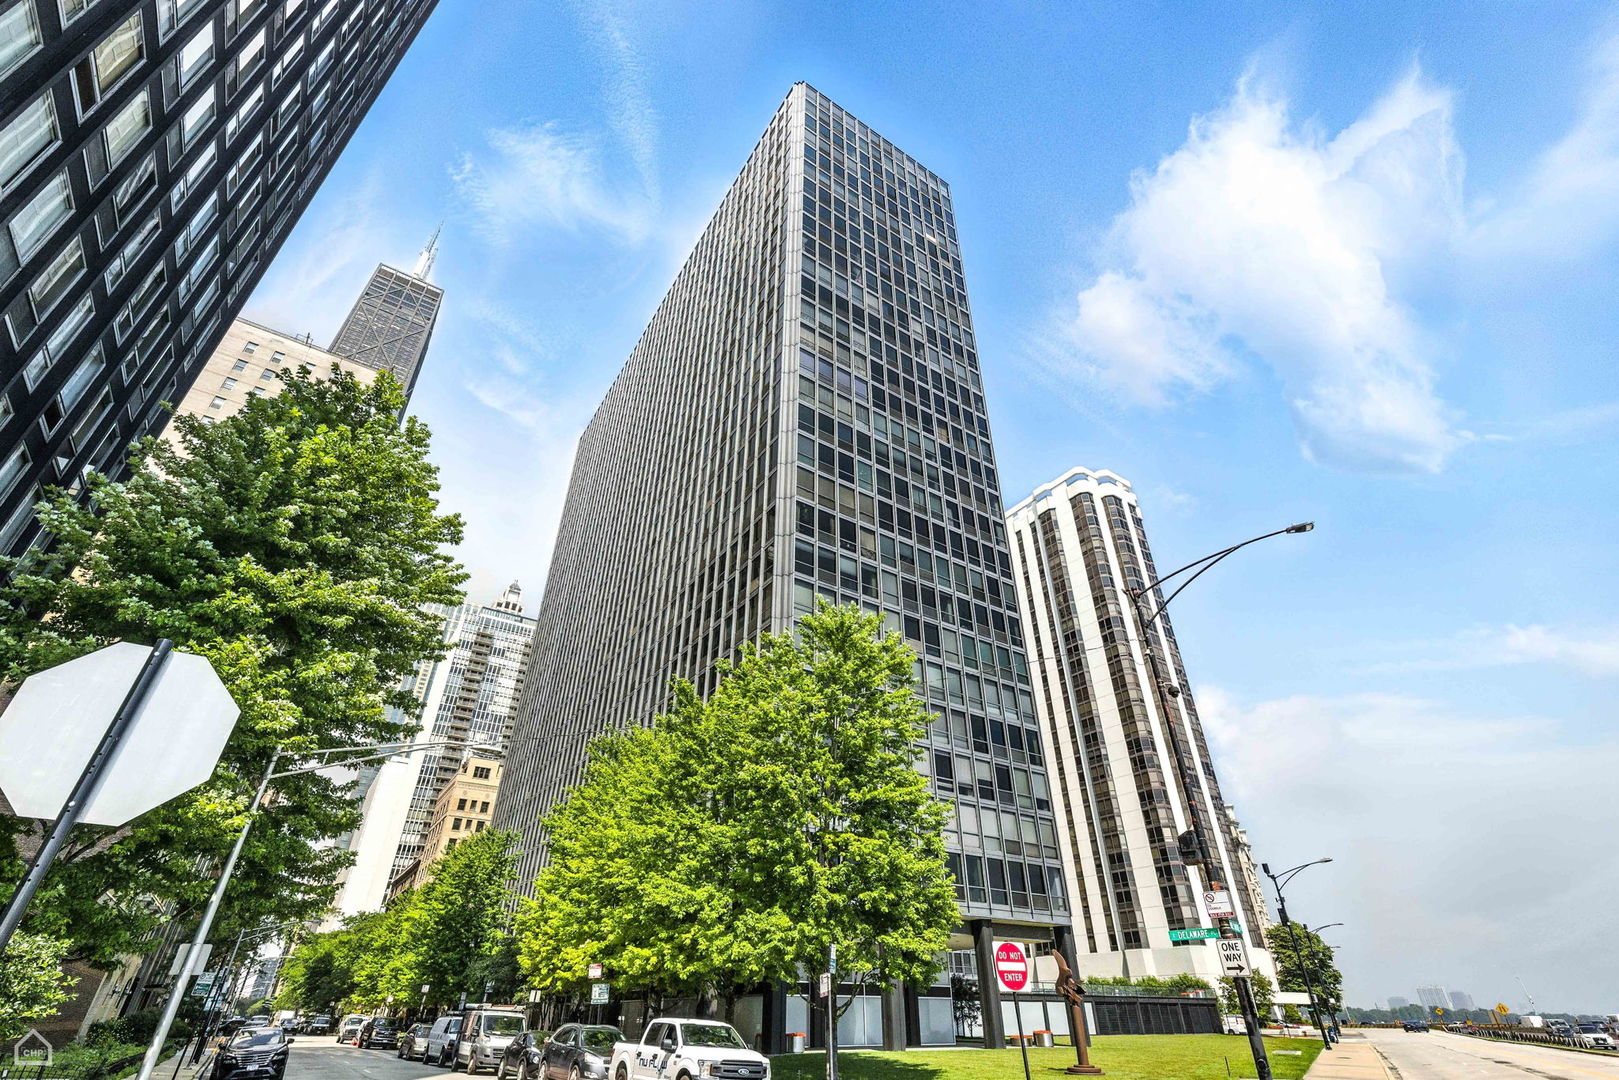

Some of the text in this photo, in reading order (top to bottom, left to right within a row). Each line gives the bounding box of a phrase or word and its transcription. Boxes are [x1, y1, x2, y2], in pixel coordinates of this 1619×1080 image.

[1177, 930, 1209, 939] DELAWARE
[1221, 942, 1240, 951] ONE
[1009, 952, 1021, 960] NOT
[1223, 953, 1242, 962] WAY
[1004, 973, 1023, 982] ENTER
